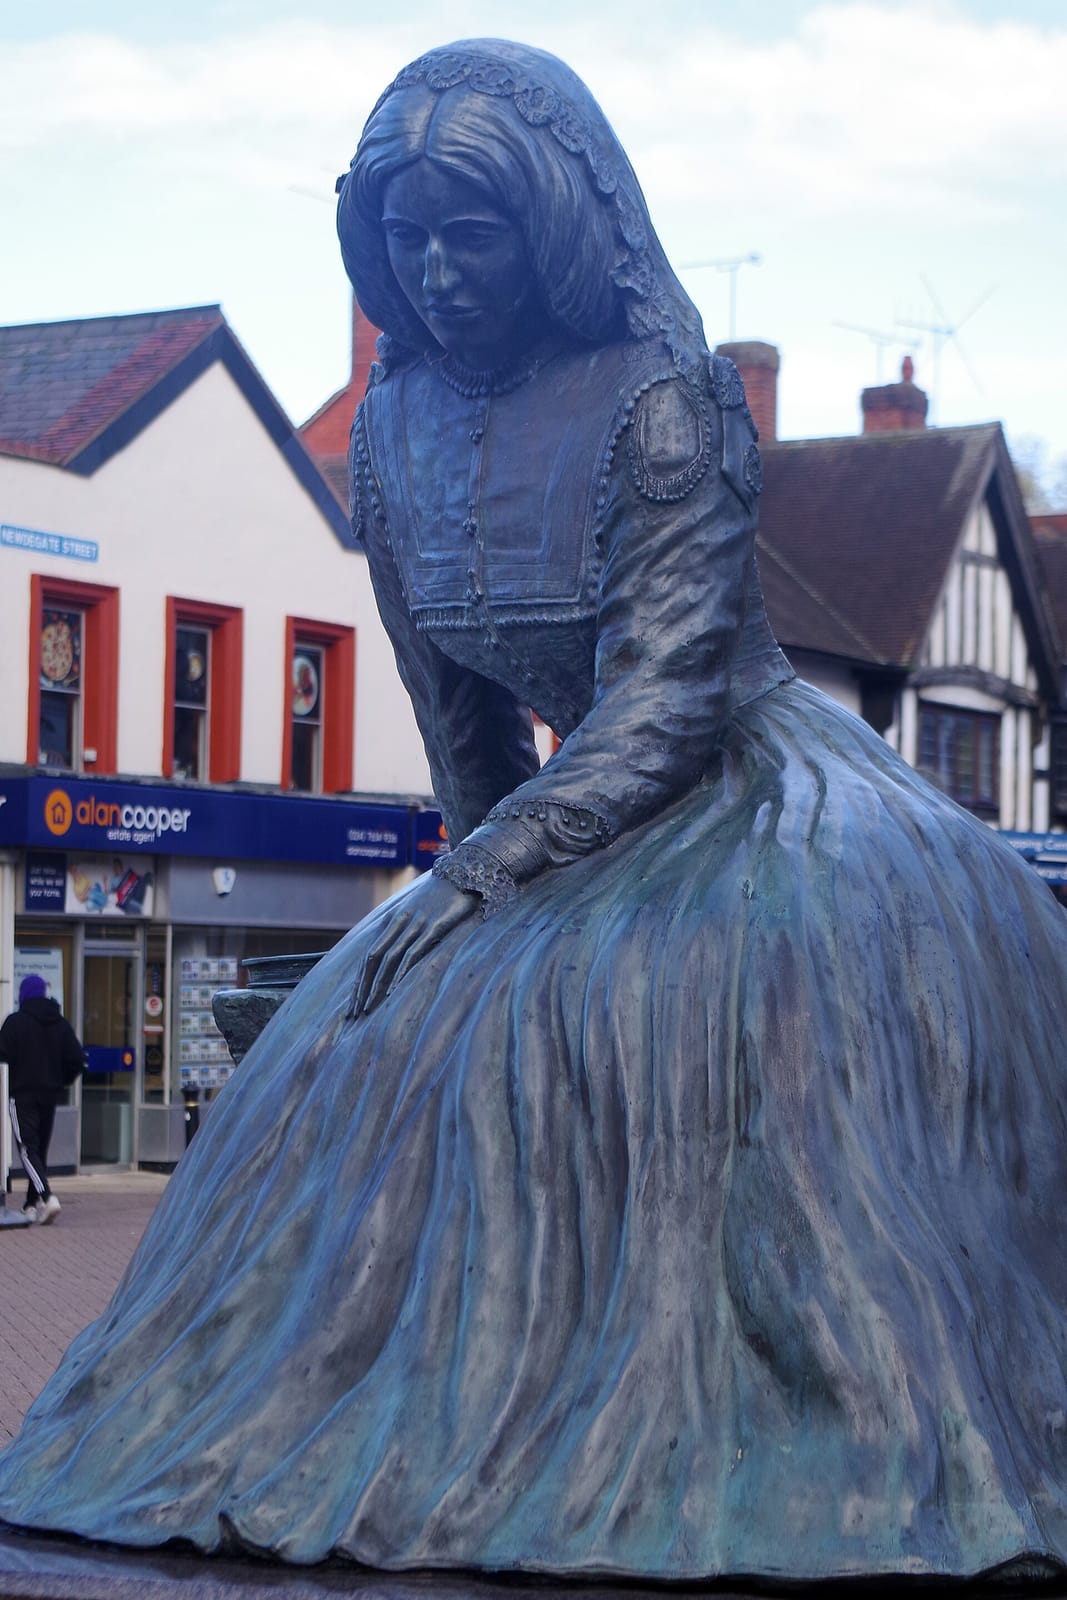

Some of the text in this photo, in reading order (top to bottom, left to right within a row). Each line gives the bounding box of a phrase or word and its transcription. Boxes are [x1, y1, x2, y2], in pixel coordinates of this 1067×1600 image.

[2, 528, 97, 559] NEWDEGATE STREET
[107, 829, 155, 844] estate agent
